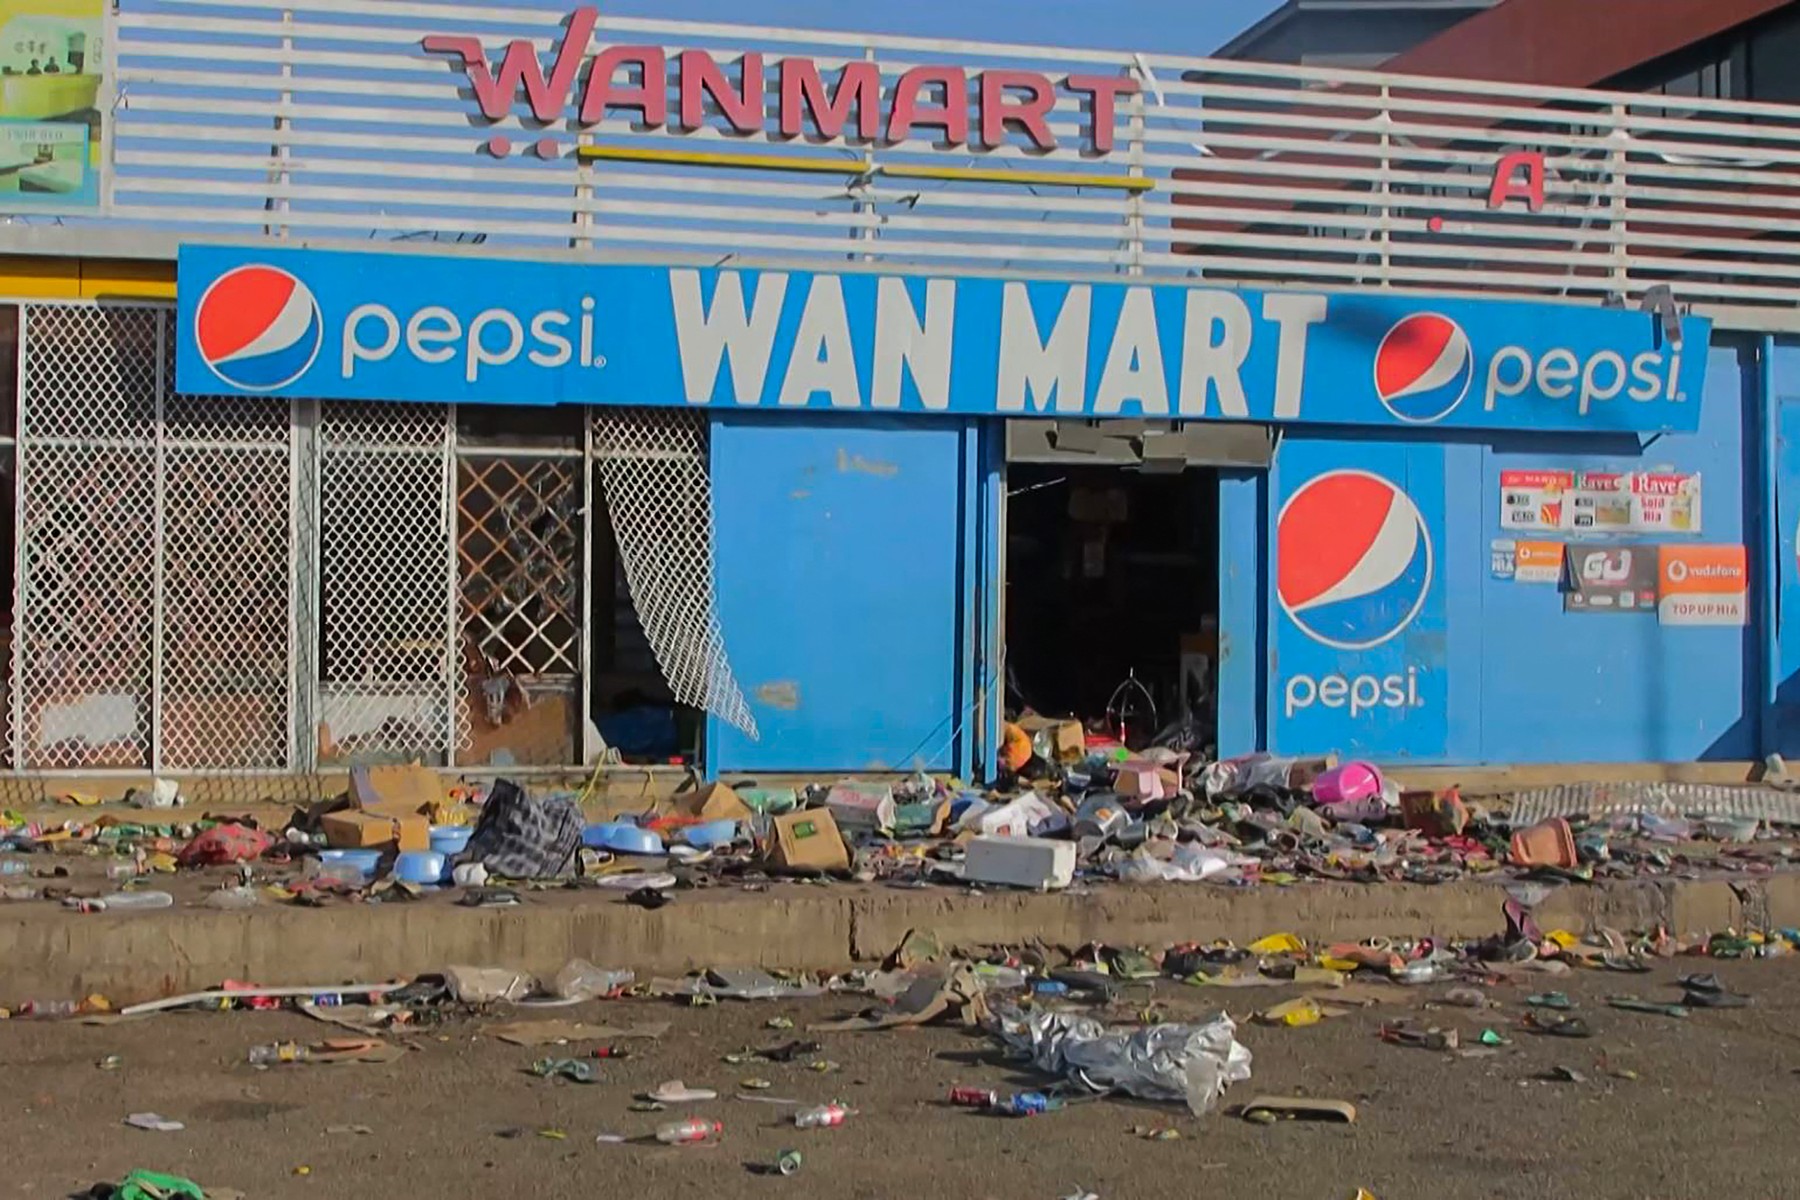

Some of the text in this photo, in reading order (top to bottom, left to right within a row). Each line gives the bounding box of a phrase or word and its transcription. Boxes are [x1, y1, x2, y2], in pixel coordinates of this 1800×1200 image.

[422, 6, 1140, 154] WANMART
[1488, 151, 1545, 212] A
[342, 296, 596, 382] pepsi
[669, 268, 1328, 418] WAN MART
[1484, 341, 1682, 415] pepsi
[1638, 475, 1676, 494] Rave
[1673, 603, 1738, 616] TOP UP HIA
[1285, 666, 1417, 718] pepsi
